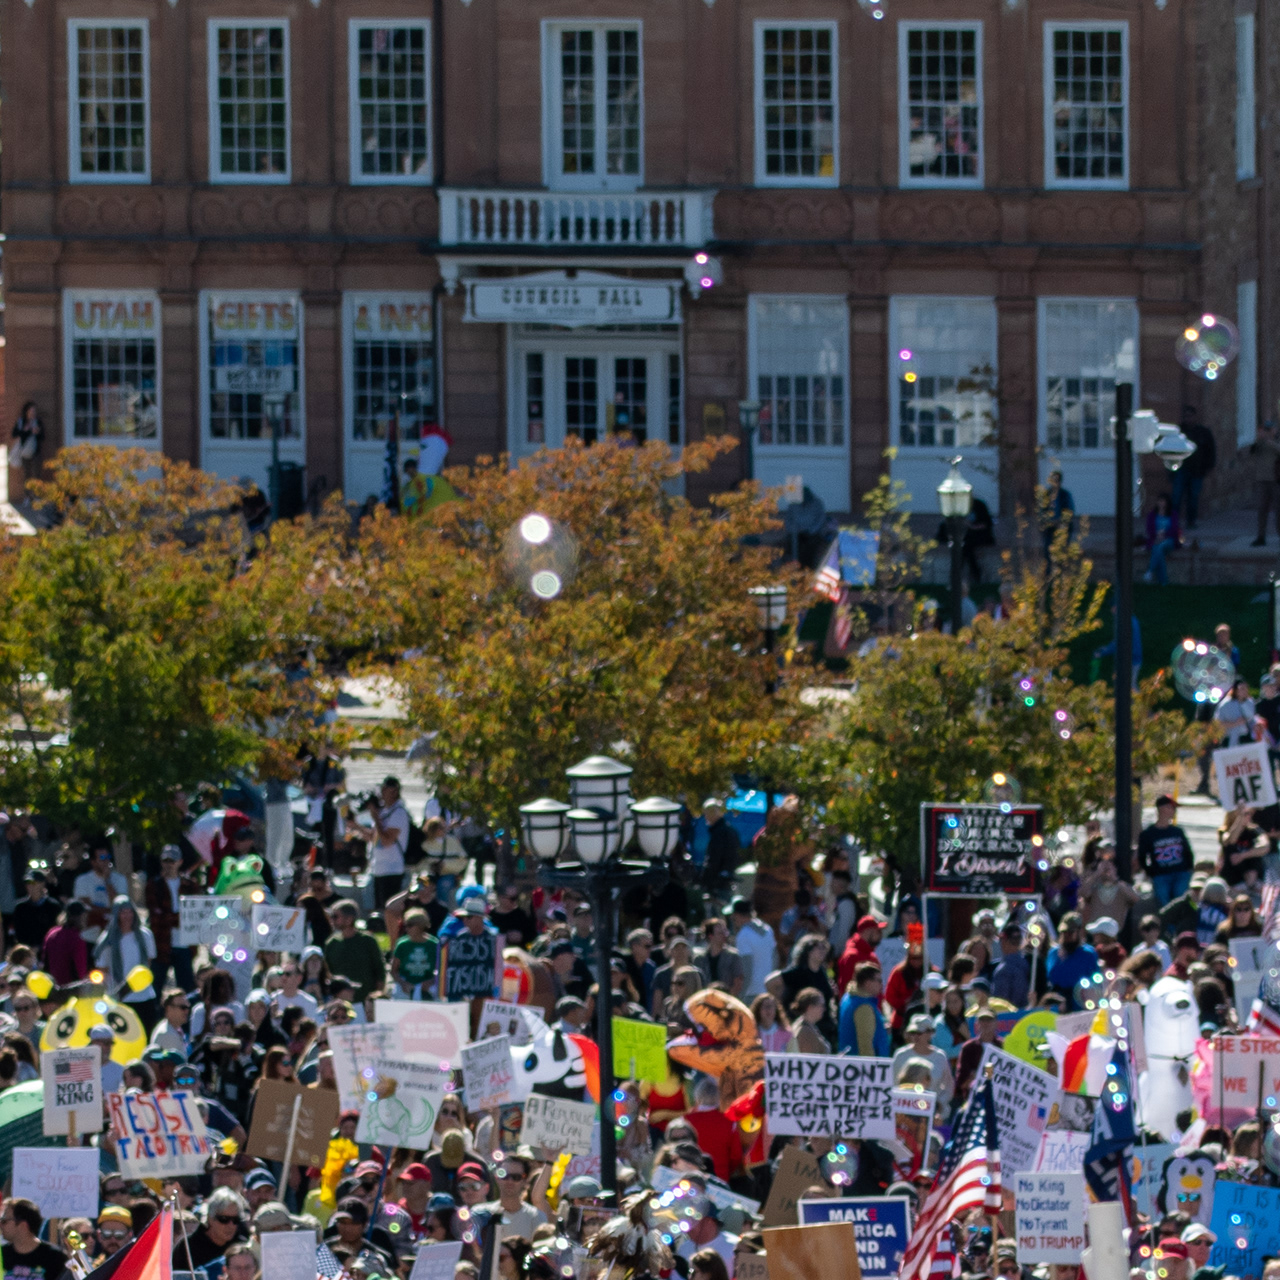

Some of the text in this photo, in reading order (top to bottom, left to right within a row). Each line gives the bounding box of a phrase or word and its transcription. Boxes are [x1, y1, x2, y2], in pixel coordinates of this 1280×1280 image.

[74, 301, 296, 329] UTAH GIFTS
[1233, 776, 1263, 804] AF
[768, 1060, 819, 1080] WHY
[56, 1083, 84, 1094] NOT
[768, 1081, 892, 1101] PRESIDENTS
[1223, 1076, 1247, 1093] WE
[55, 1093, 94, 1106] KING
[106, 1092, 194, 1137] RESIST
[768, 1101, 892, 1120] FIGHT THEIR
[796, 1119, 867, 1135] WARS?
[1039, 1180, 1065, 1197] King
[1034, 1218, 1068, 1234] Tyrant
[1020, 1237, 1037, 1249] NO
